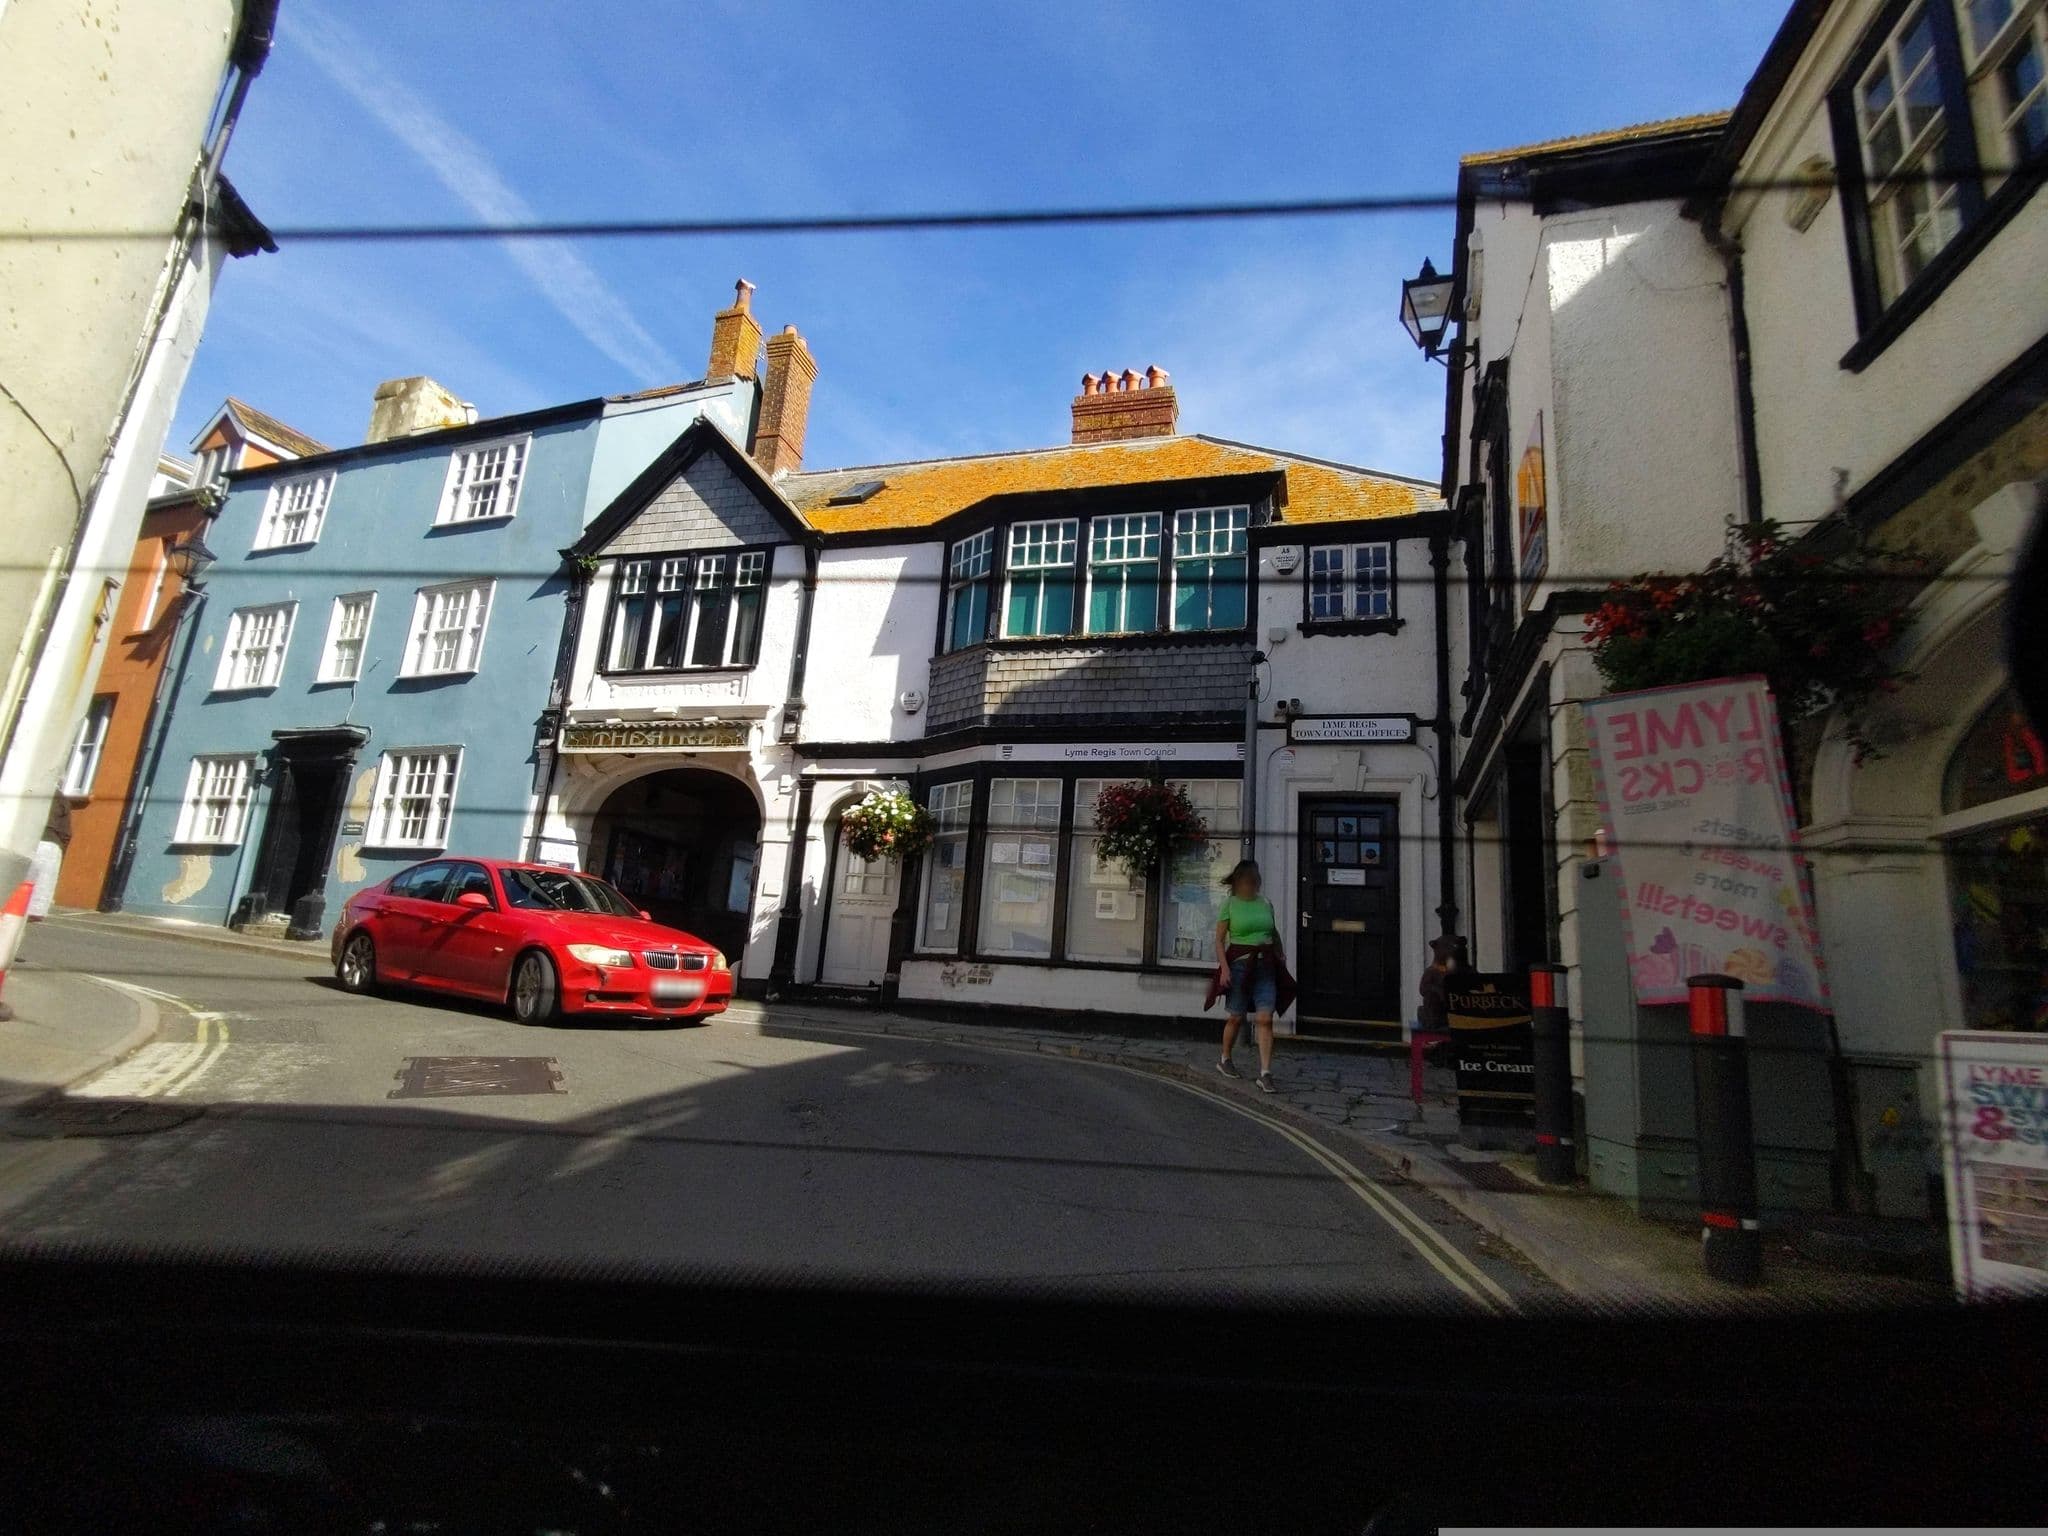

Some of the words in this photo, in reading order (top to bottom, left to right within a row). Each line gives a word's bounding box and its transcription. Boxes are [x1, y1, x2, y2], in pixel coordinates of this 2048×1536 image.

[1321, 720, 1347, 729] LYME
[1349, 720, 1378, 729] REGIS
[1294, 729, 1322, 738] TOWN
[1323, 729, 1365, 738] COUNCIL
[1367, 728, 1408, 737] OFFICES
[1064, 747, 1089, 758] Lyme
[1091, 747, 1117, 758] Regis
[1119, 746, 1142, 757] Town
[1143, 746, 1177, 756] Council
[1458, 1059, 1482, 1072] Ice
[1485, 1060, 1536, 1074] Cream
